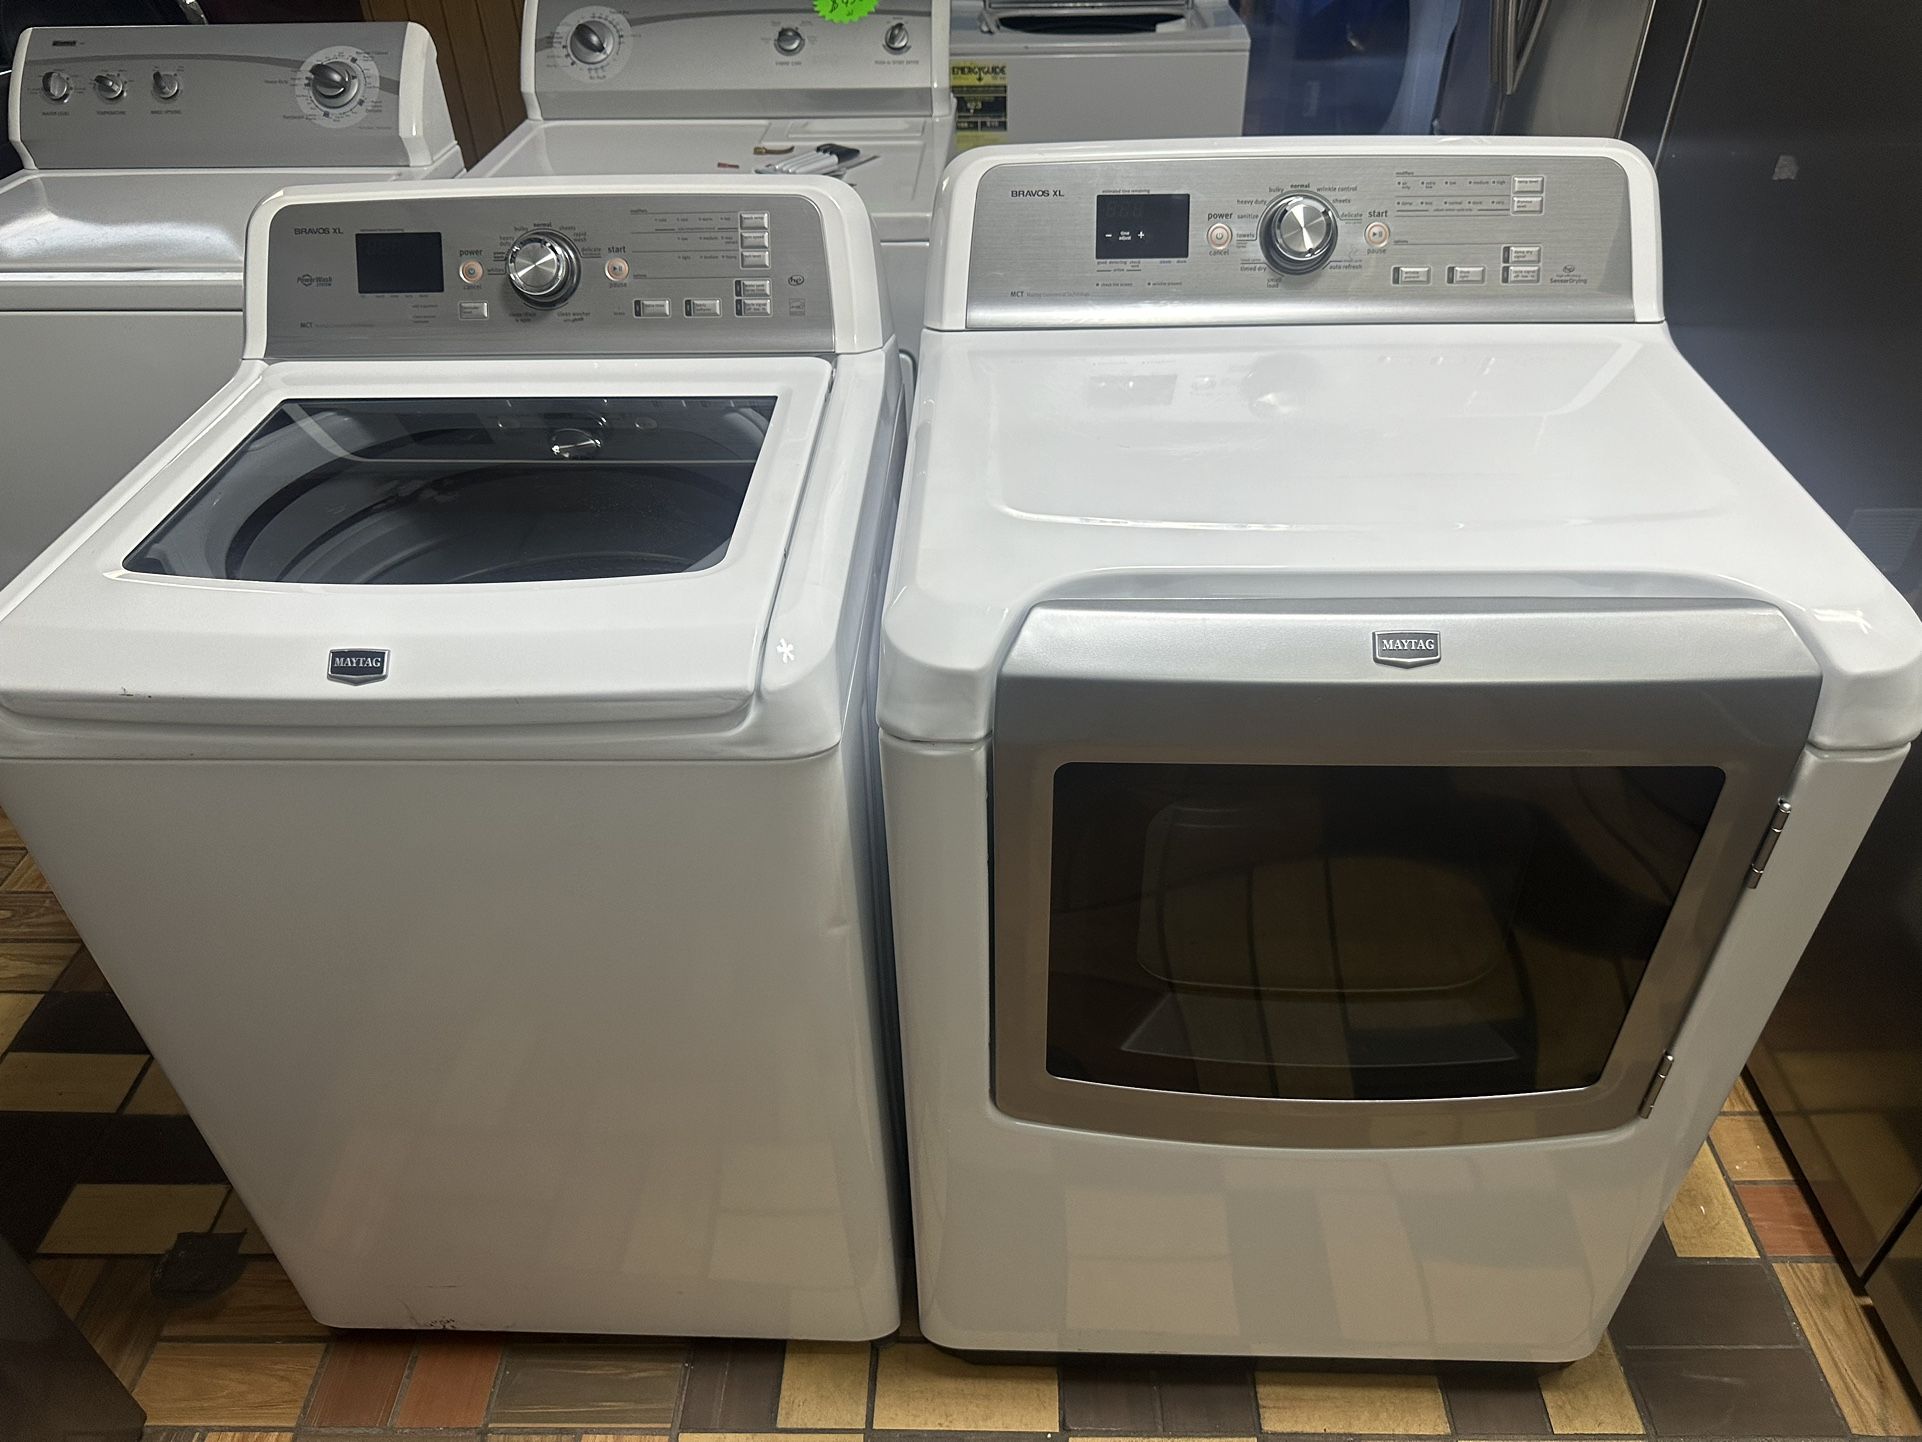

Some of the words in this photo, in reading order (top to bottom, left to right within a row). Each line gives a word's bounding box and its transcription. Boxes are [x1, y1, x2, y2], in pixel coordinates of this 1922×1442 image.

[1011, 189, 1050, 198] BRAVOS
[1052, 189, 1064, 197] XL
[1269, 186, 1284, 194] bulky
[1207, 212, 1233, 220] power
[1368, 210, 1388, 218] start
[459, 249, 483, 257] power
[1382, 639, 1435, 650] MAYTAG
[334, 657, 381, 667] MAYTAG
